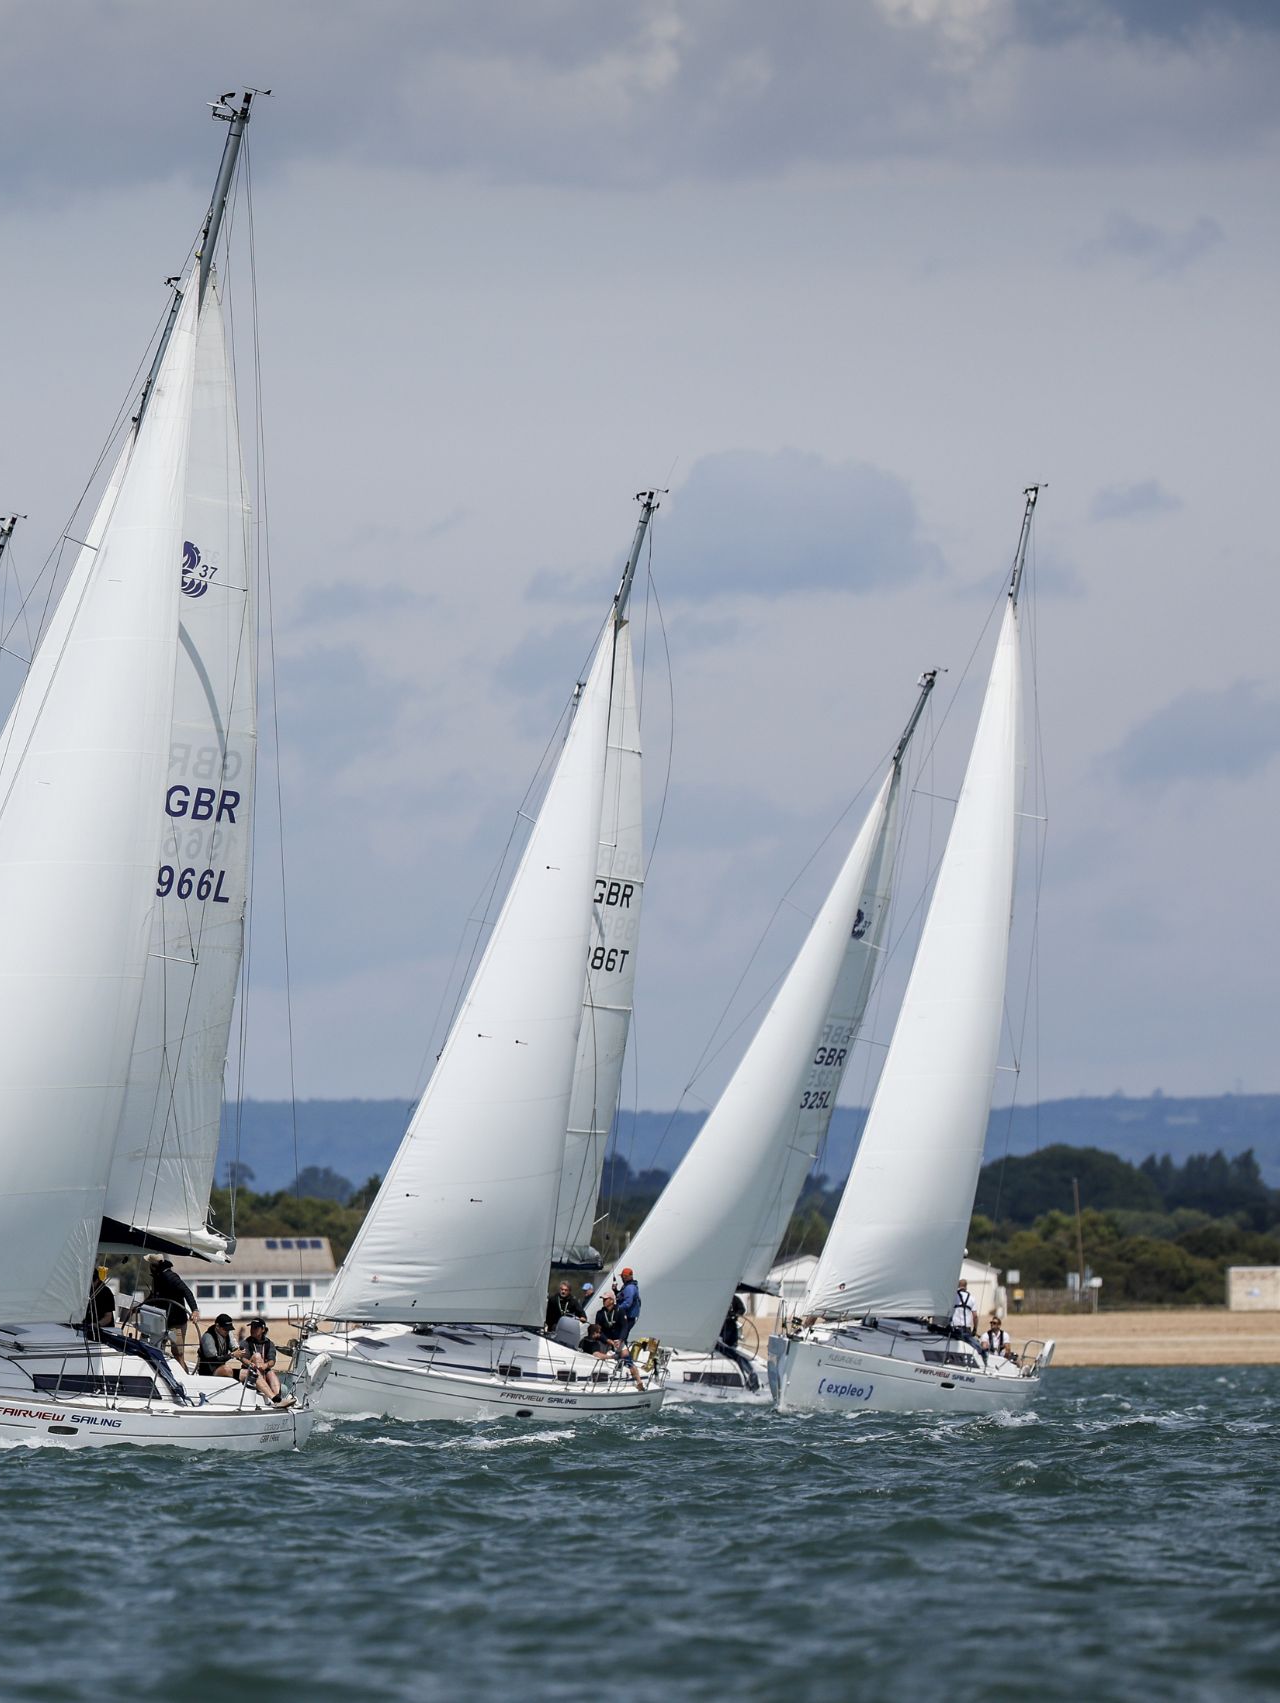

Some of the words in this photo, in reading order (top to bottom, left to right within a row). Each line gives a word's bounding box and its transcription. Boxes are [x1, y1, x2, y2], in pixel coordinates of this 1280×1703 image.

[199, 564, 218, 580] 37
[165, 784, 240, 824] GBR
[156, 865, 230, 903] 966L
[593, 879, 634, 908] GBR
[587, 945, 630, 973] 86T
[814, 1046, 848, 1067] GBR
[800, 1090, 832, 1110] 325L
[914, 1367, 951, 1379] FAIRVIEW
[500, 1391, 544, 1402] FAIRVIEW
[547, 1396, 577, 1405] SAILING
[70, 1414, 122, 1428] SAILING
